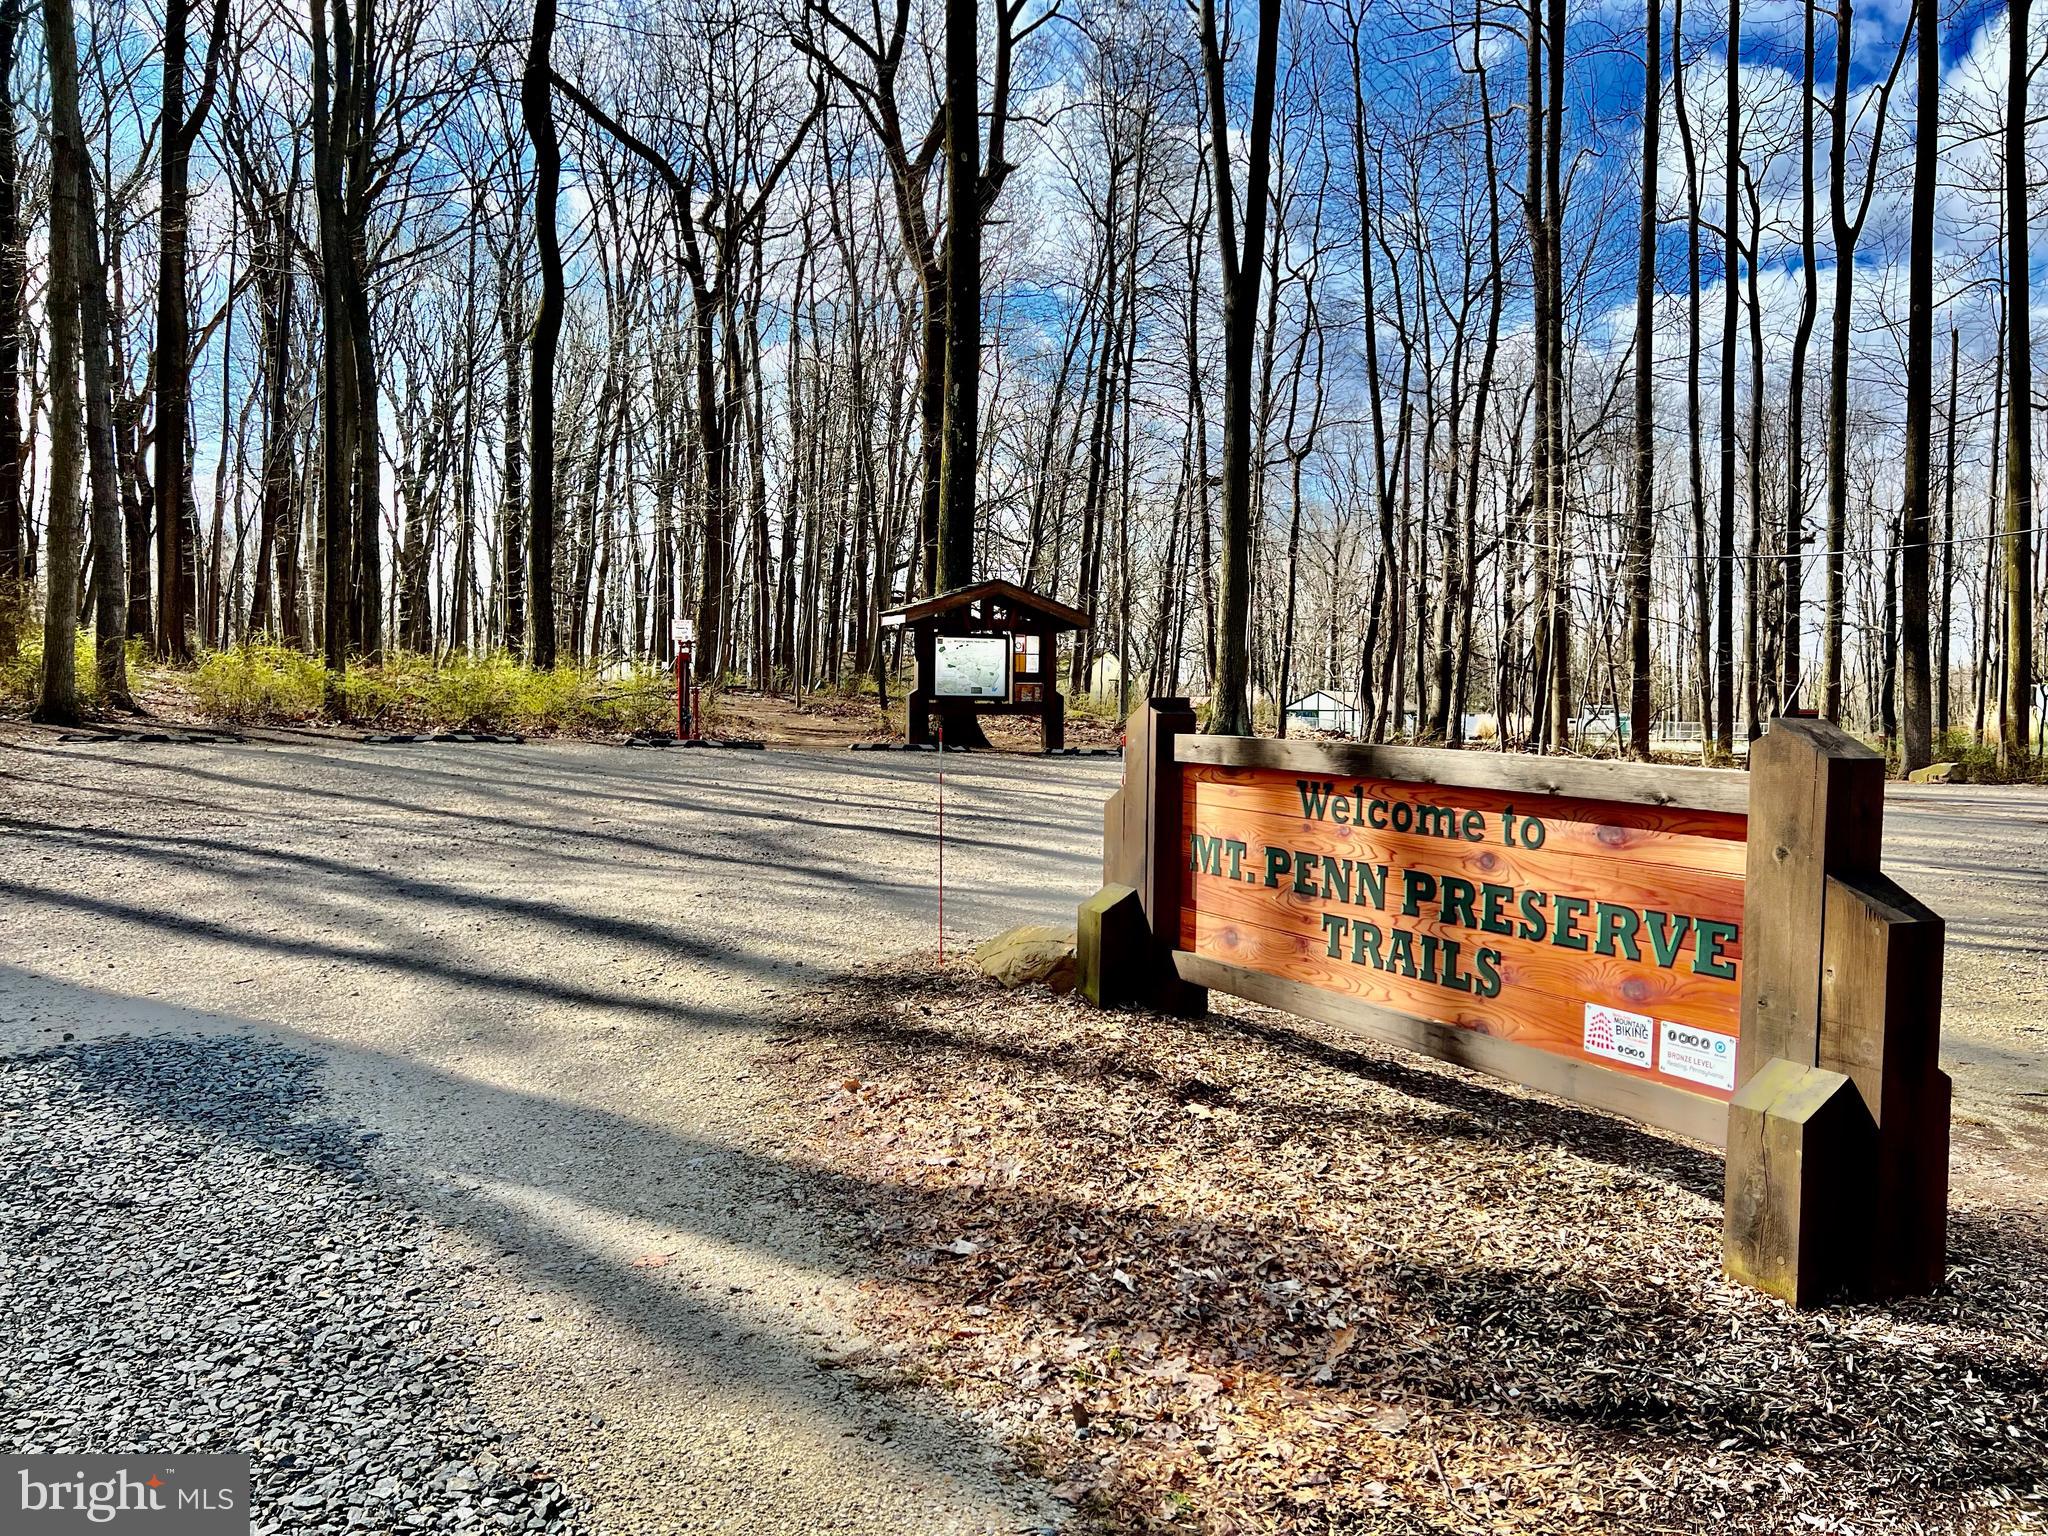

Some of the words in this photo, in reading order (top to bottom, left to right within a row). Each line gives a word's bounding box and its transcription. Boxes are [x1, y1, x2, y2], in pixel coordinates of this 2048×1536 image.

[1296, 779, 1486, 842] Welcome
[1501, 804, 1546, 850] to
[1190, 832, 1256, 884] MT.
[1263, 845, 1389, 911] PENN
[1401, 868, 1739, 981] PRESERVE
[1321, 912, 1502, 998] TRAILS
[1613, 1017, 1647, 1029] MOUNTAIN
[1615, 1025, 1649, 1040] BIKING
[1667, 1051, 1692, 1064] BRONZE
[1693, 1057, 1713, 1069] LEVEL
